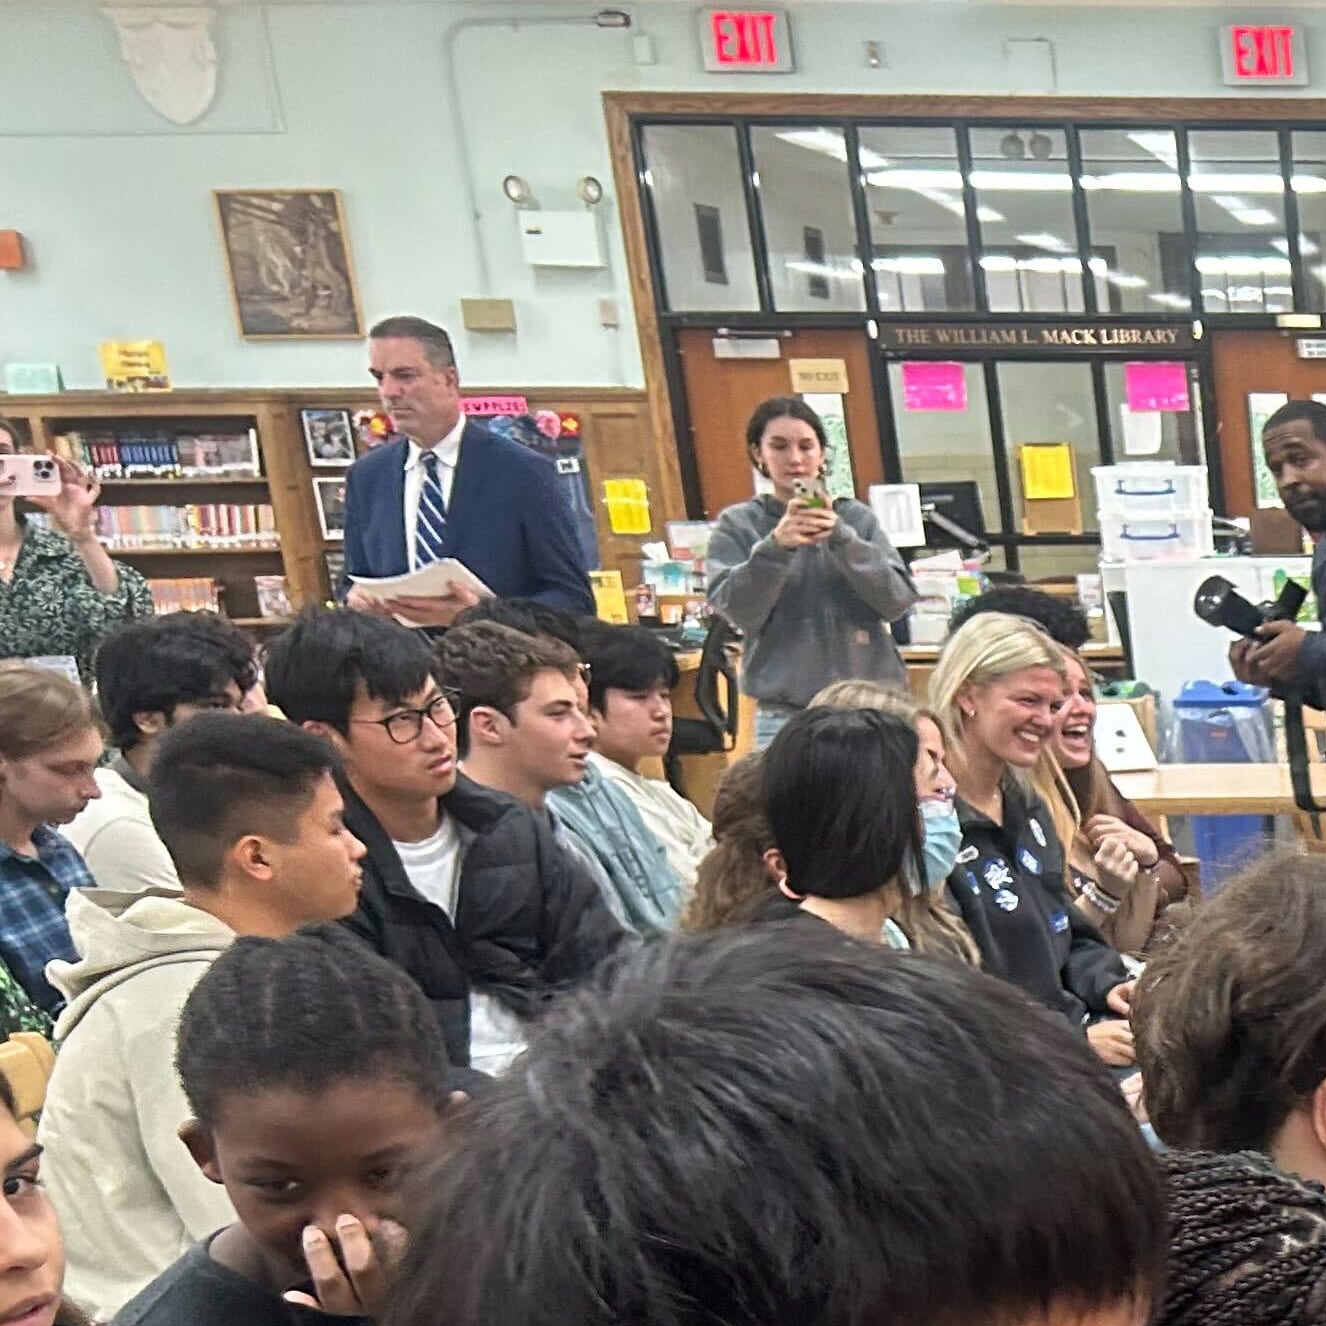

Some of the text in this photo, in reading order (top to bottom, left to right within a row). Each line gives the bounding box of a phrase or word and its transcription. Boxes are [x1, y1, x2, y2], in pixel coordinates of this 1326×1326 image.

[714, 12, 776, 65] EXIT
[1234, 25, 1293, 77] EXIT
[896, 329, 1179, 345] THE WILLIAM L. MACK LIBRARY
